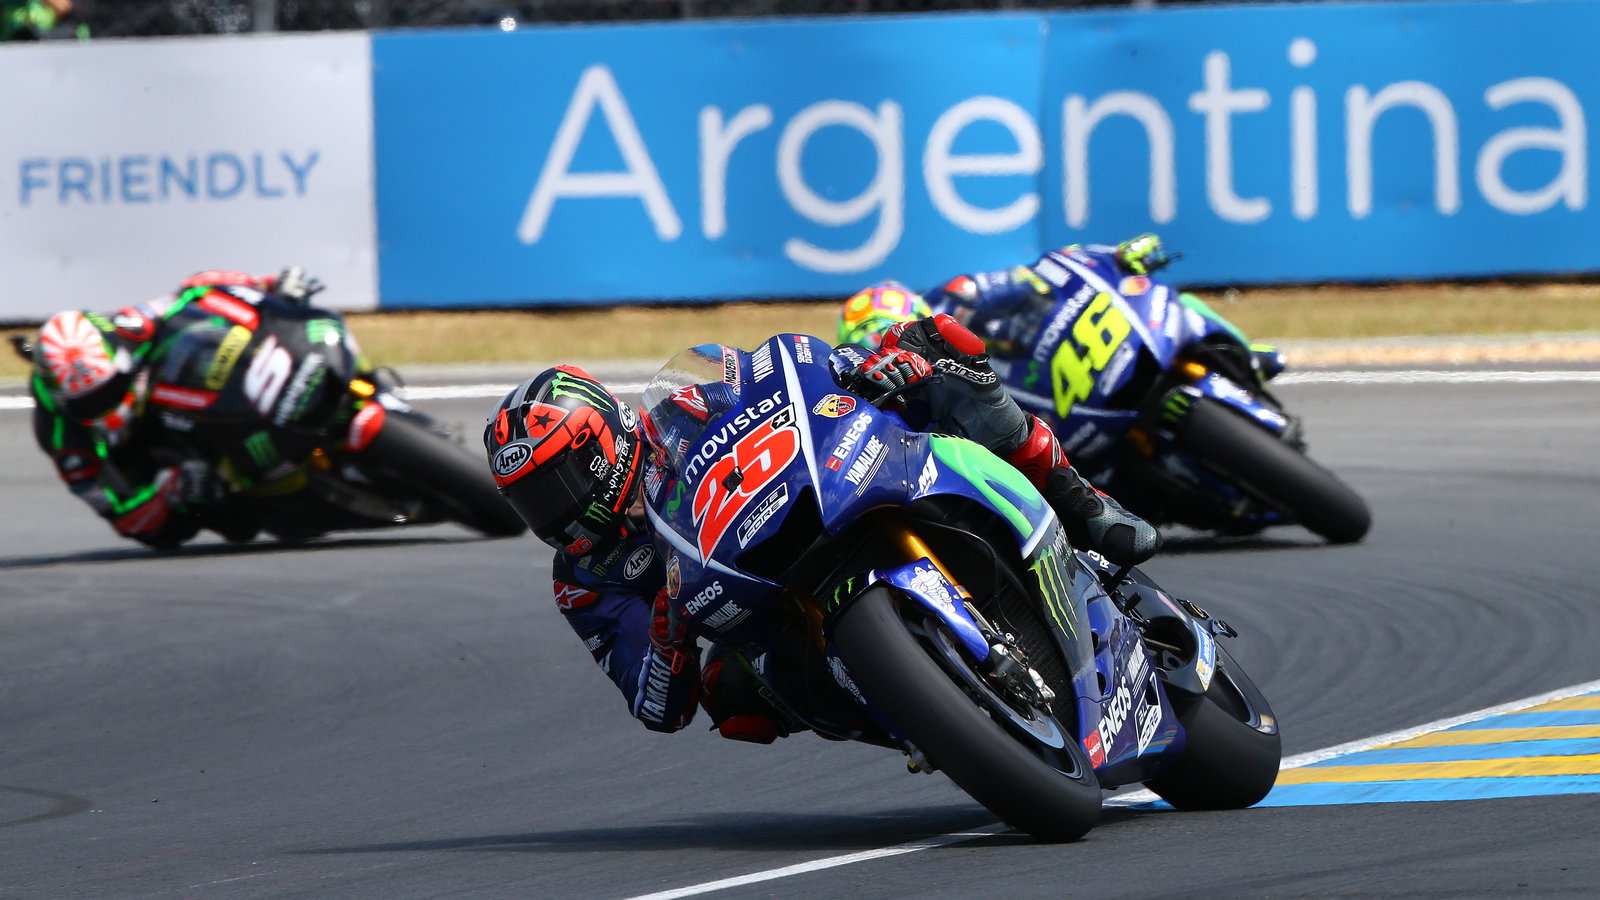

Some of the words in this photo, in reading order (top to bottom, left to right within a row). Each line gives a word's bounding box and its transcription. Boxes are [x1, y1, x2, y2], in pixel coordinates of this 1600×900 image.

[19, 151, 321, 206] FRIENDLY
[518, 38, 1588, 274] Argentina
[1051, 292, 1131, 419] 46
[499, 445, 525, 471] Arai
[684, 390, 783, 485] movistar
[833, 412, 873, 461] ENEOS
[844, 434, 884, 486] YAMALUBE
[595, 458, 608, 478] LANG
[603, 440, 631, 502] MONSTER
[692, 403, 801, 567] 25
[743, 491, 779, 530] BLUE
[746, 500, 780, 540] CORE
[628, 546, 651, 578] Arai
[685, 580, 724, 616] ENEOS
[702, 600, 742, 629] YAMALUBE
[1098, 675, 1132, 764] ENEOS
